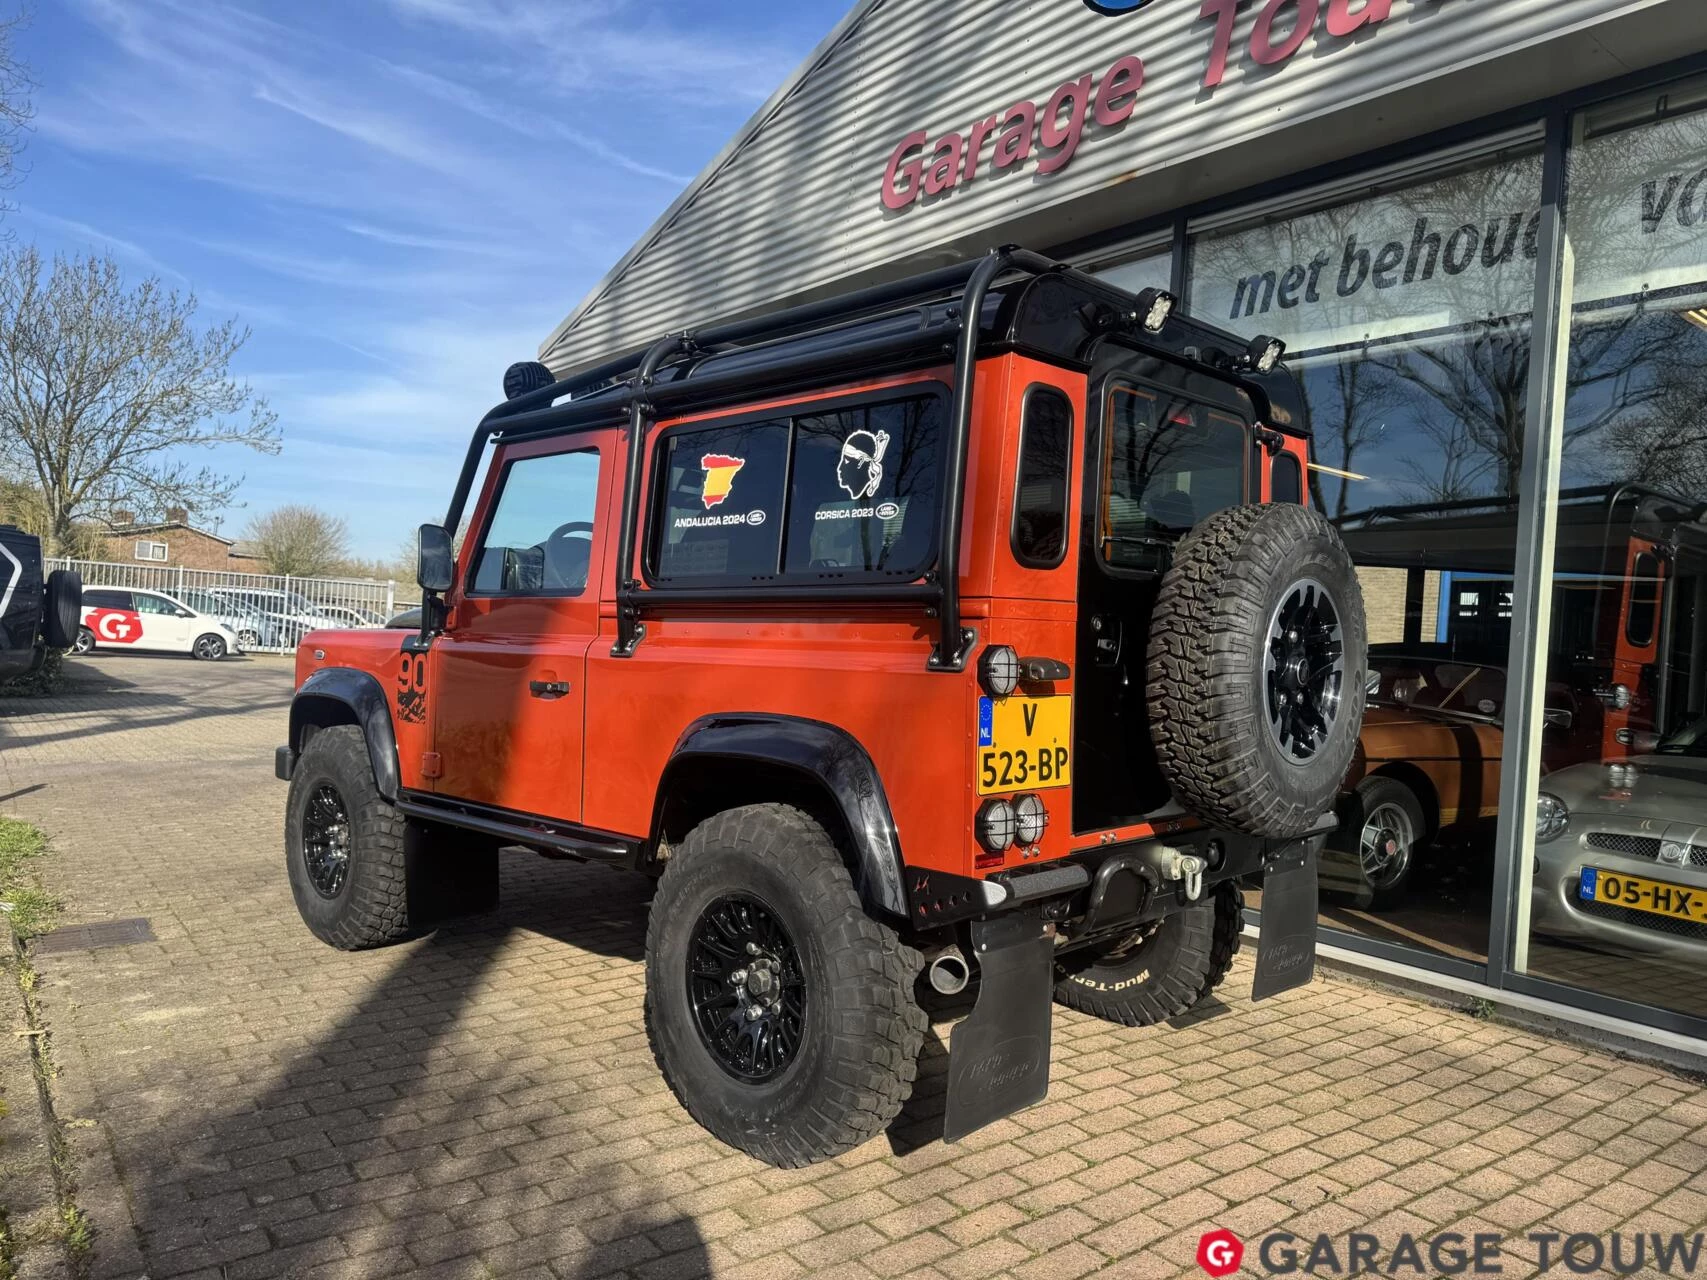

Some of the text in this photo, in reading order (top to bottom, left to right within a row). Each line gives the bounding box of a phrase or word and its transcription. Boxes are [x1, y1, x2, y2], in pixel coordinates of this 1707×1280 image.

[881, 55, 1144, 209] Garage
[1229, 249, 1329, 320] met
[674, 516, 722, 528] ANDALUCIA
[722, 513, 746, 526] 2024
[815, 507, 874, 520] CORSICA 2023
[398, 652, 427, 694] 90
[980, 727, 991, 739] NL
[1022, 703, 1038, 737] V
[982, 747, 1068, 788] 523-BP
[1582, 885, 1594, 895] NL
[1603, 877, 1707, 919] 05-HX-
